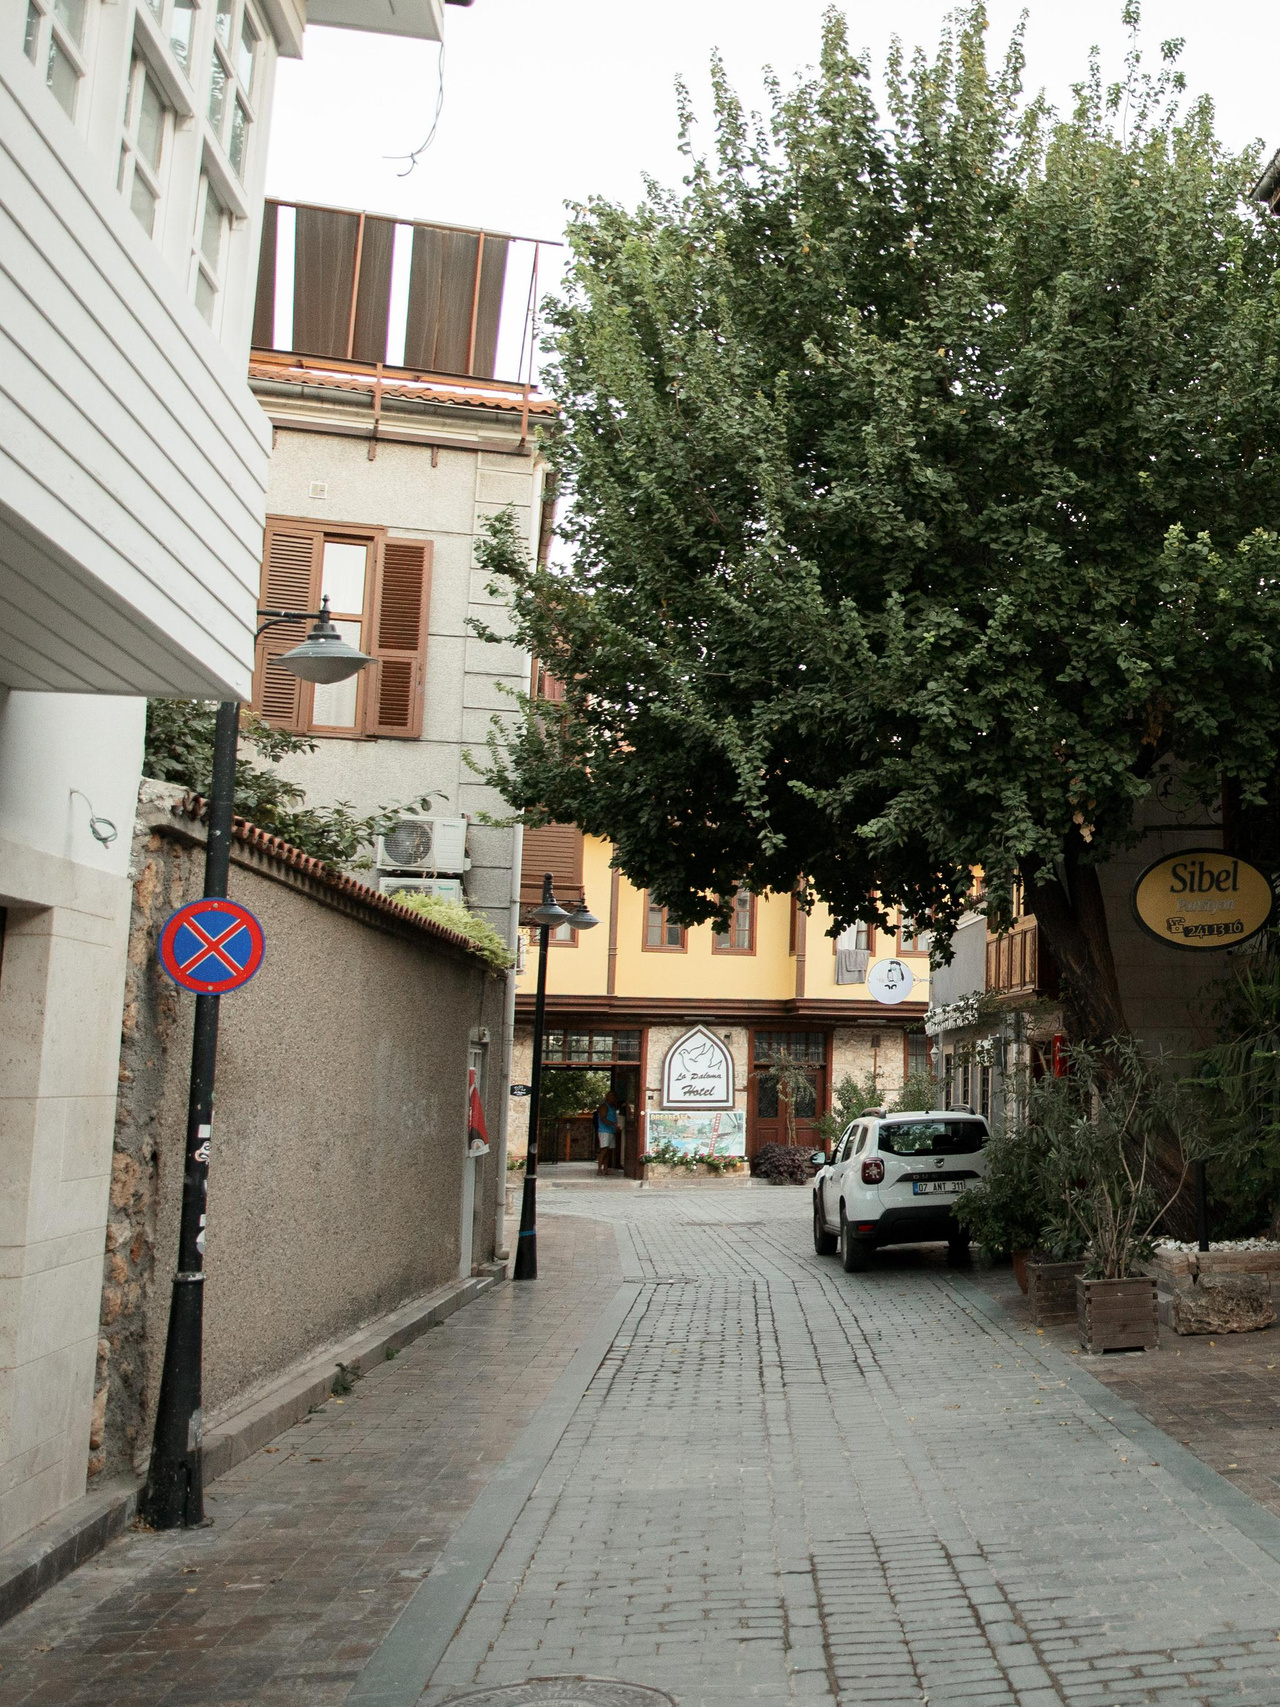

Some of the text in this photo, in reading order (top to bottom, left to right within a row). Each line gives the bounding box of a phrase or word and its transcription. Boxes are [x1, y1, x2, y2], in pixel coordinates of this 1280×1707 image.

[1169, 860, 1239, 893] Sibel
[1188, 919, 1242, 938] 241 13 16
[675, 1071, 722, 1081] La Paloma
[681, 1084, 716, 1097] Hotel
[918, 1181, 963, 1192] 07 ANT 311
